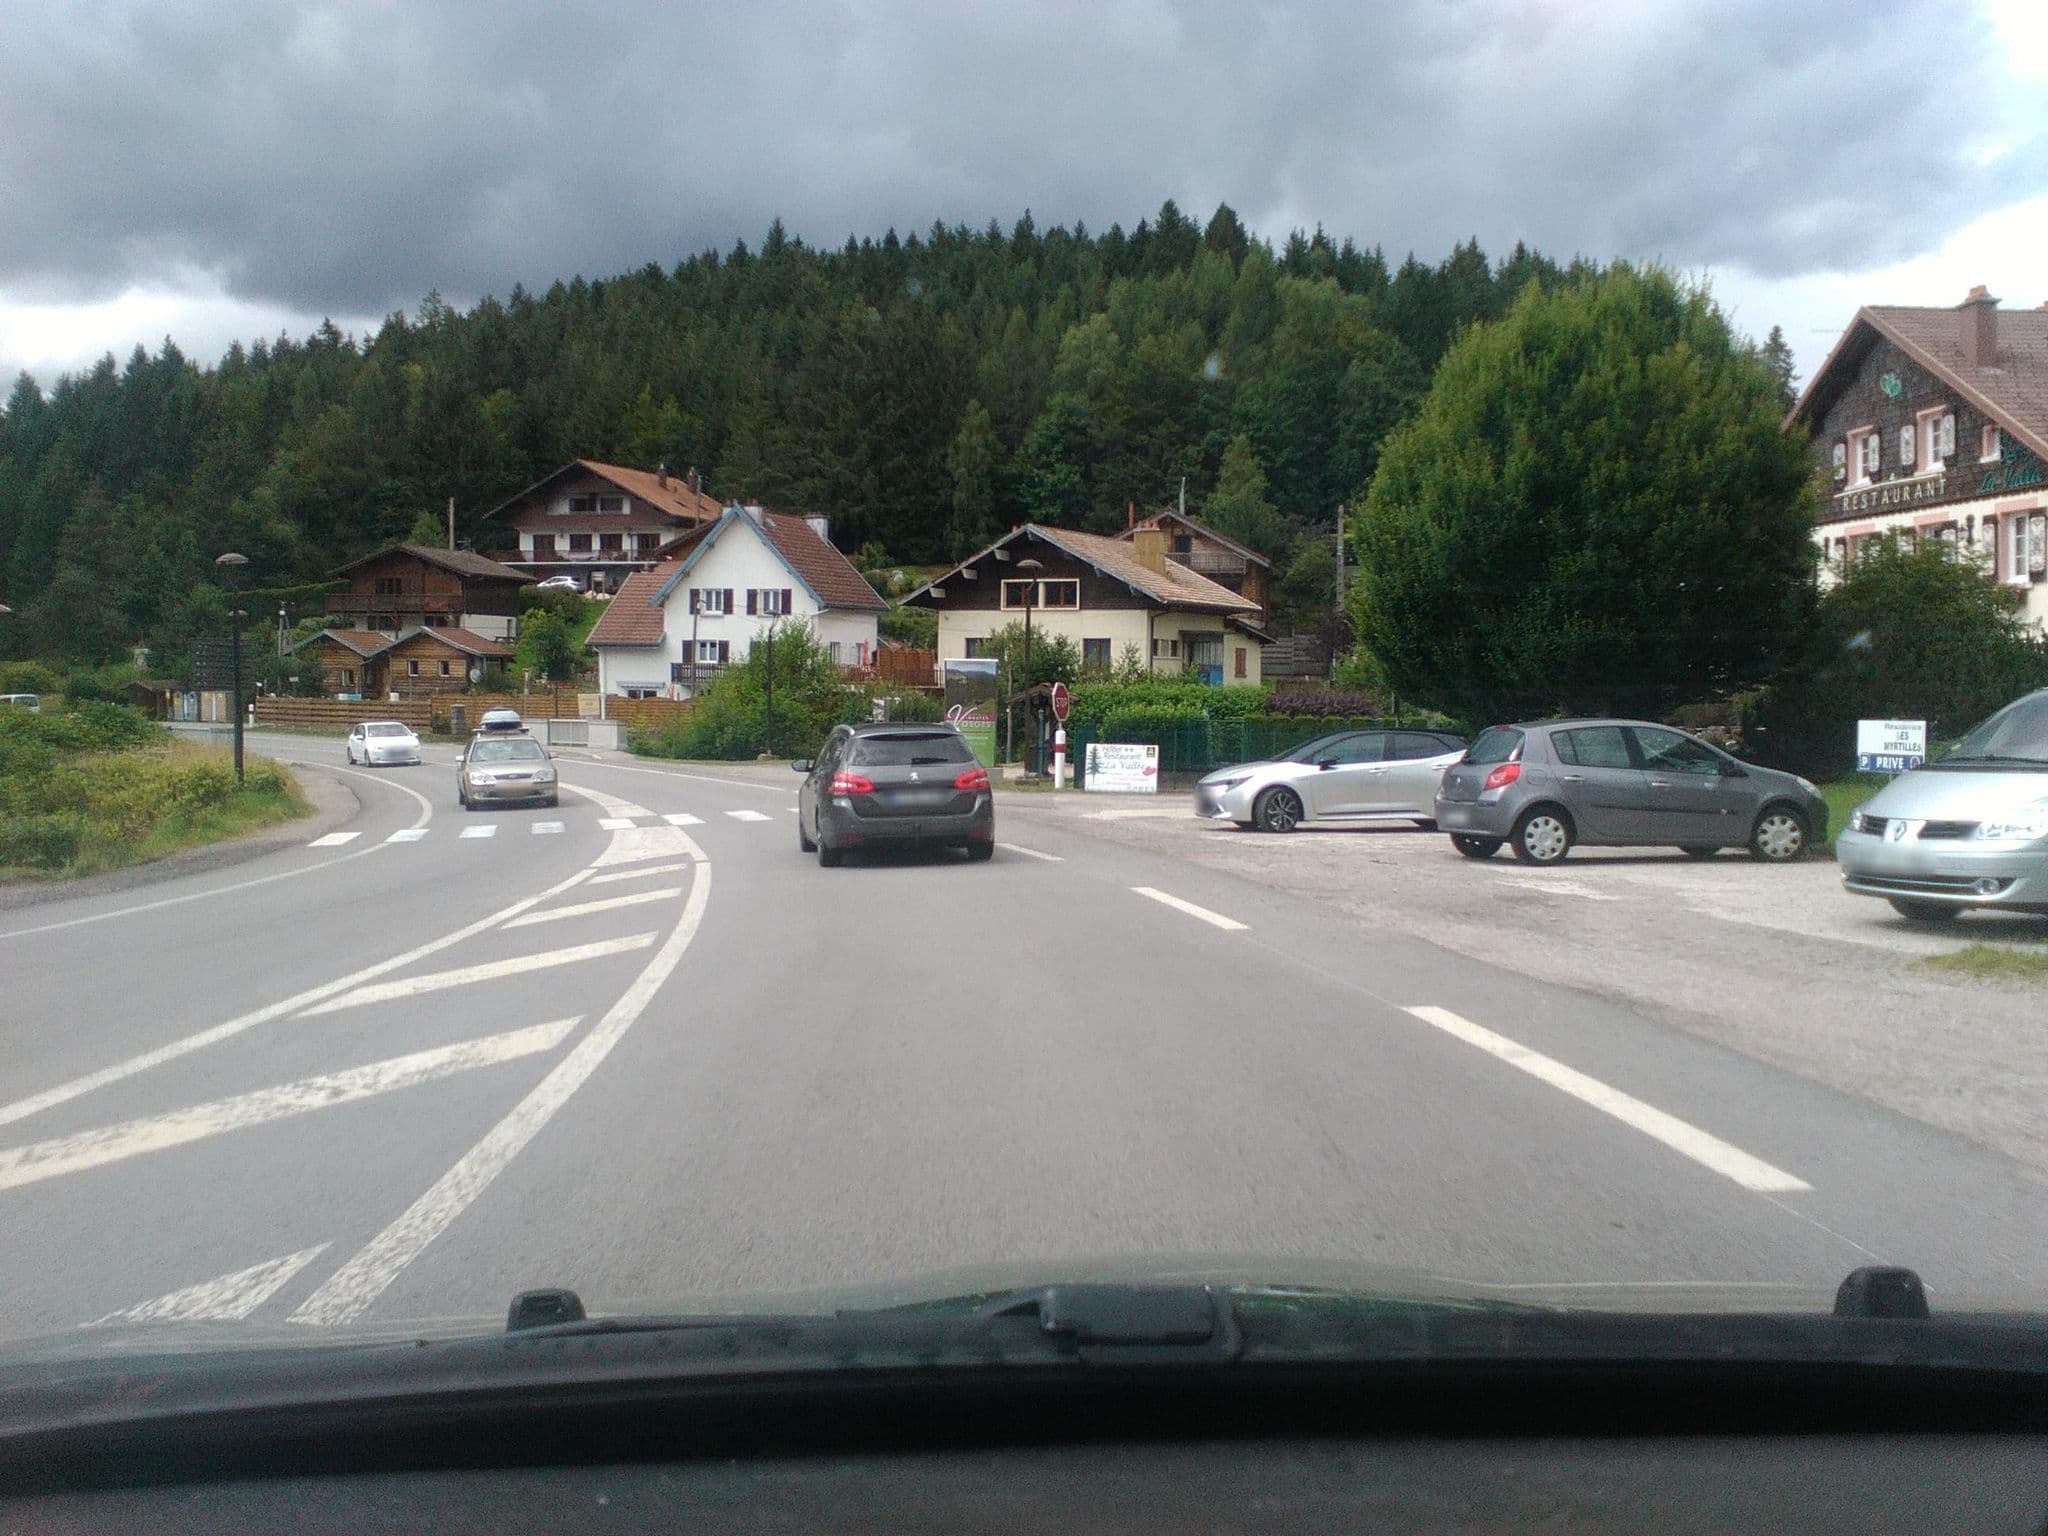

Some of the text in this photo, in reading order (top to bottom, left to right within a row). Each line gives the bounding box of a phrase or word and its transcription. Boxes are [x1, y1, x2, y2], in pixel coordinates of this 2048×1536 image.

[1843, 478, 1947, 511] RESTAURANT
[1056, 697, 1068, 708] STOP
[1884, 741, 1922, 752] MYRTILLES
